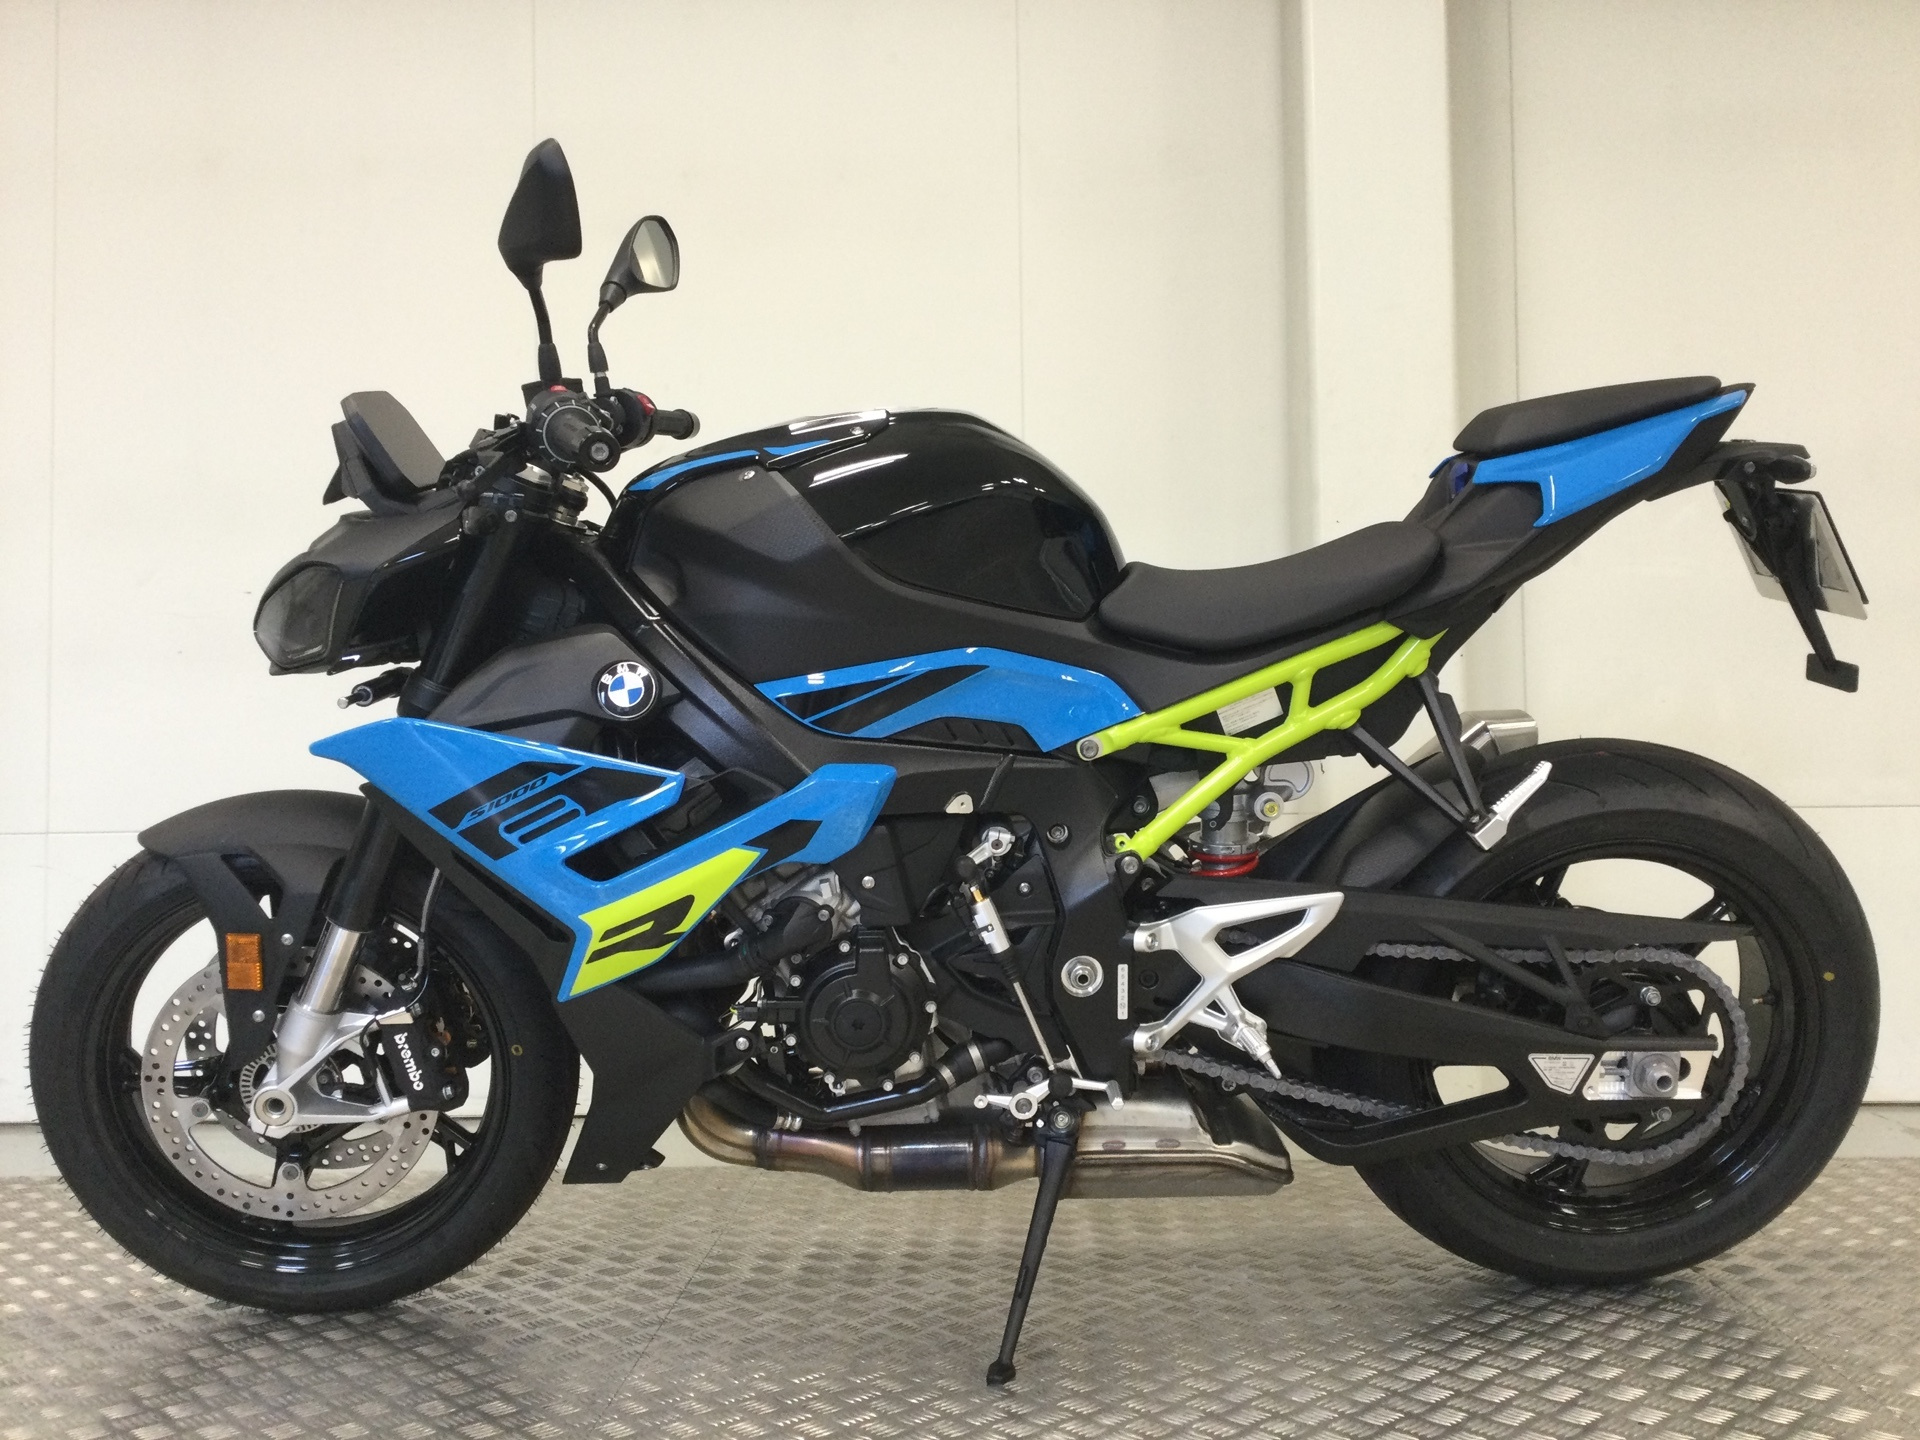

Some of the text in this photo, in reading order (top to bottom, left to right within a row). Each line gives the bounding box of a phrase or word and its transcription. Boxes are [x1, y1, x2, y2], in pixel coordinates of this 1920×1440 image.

[600, 662, 650, 685] BMW
[467, 776, 549, 822] S1000
[586, 894, 695, 965] R
[394, 1032, 423, 1091] brembo
